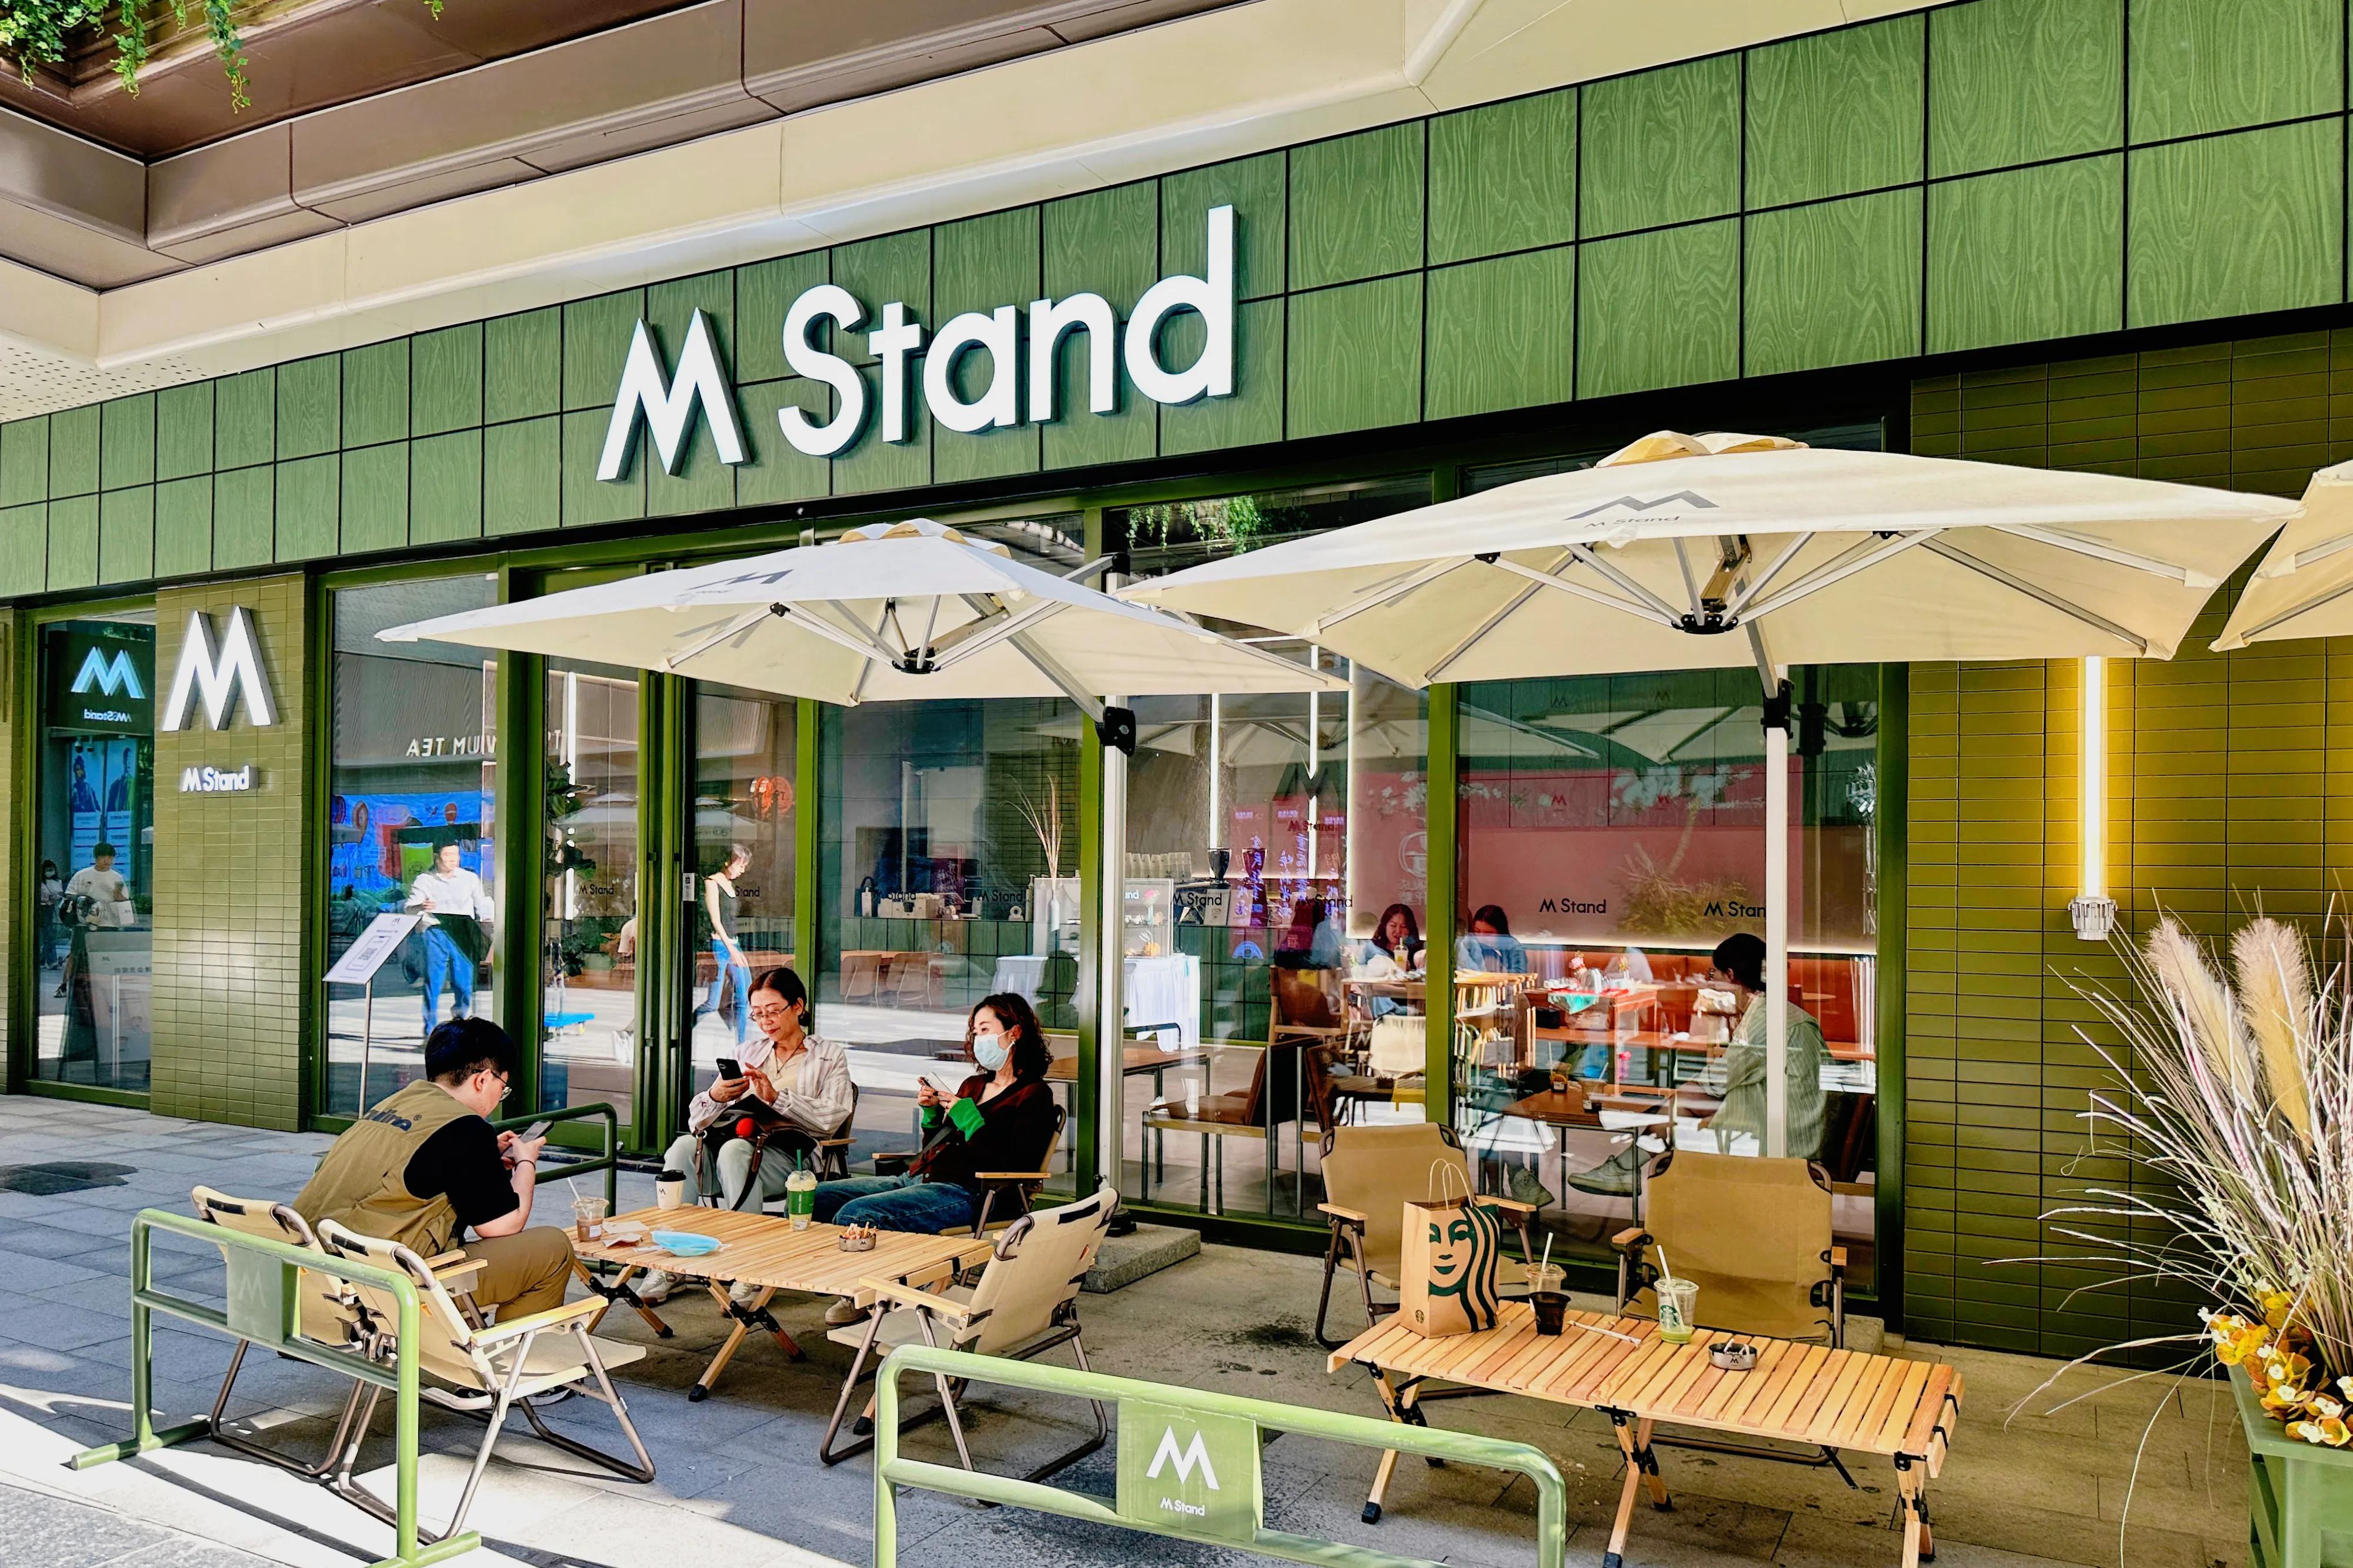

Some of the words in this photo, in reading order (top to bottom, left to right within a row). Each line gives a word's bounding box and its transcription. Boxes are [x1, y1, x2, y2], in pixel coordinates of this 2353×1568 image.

[596, 306, 750, 482] M
[778, 203, 1237, 457] Stand
[1613, 516, 1680, 525] Stand
[162, 606, 274, 731] M
[182, 767, 203, 791] M
[203, 765, 253, 791] Stand
[590, 884, 614, 895] Stand
[992, 889, 1023, 902] Stand
[1173, 893, 1183, 905] M
[1187, 892, 1222, 906] Stand
[1314, 894, 1353, 908] Stand
[1539, 898, 1557, 913] M
[1561, 898, 1607, 914] Stand
[1704, 901, 1724, 917] M
[1728, 901, 1766, 918] Stan
[1146, 1425, 1220, 1490] M
[1160, 1497, 1173, 1510] M
[1174, 1499, 1206, 1517] Stand
